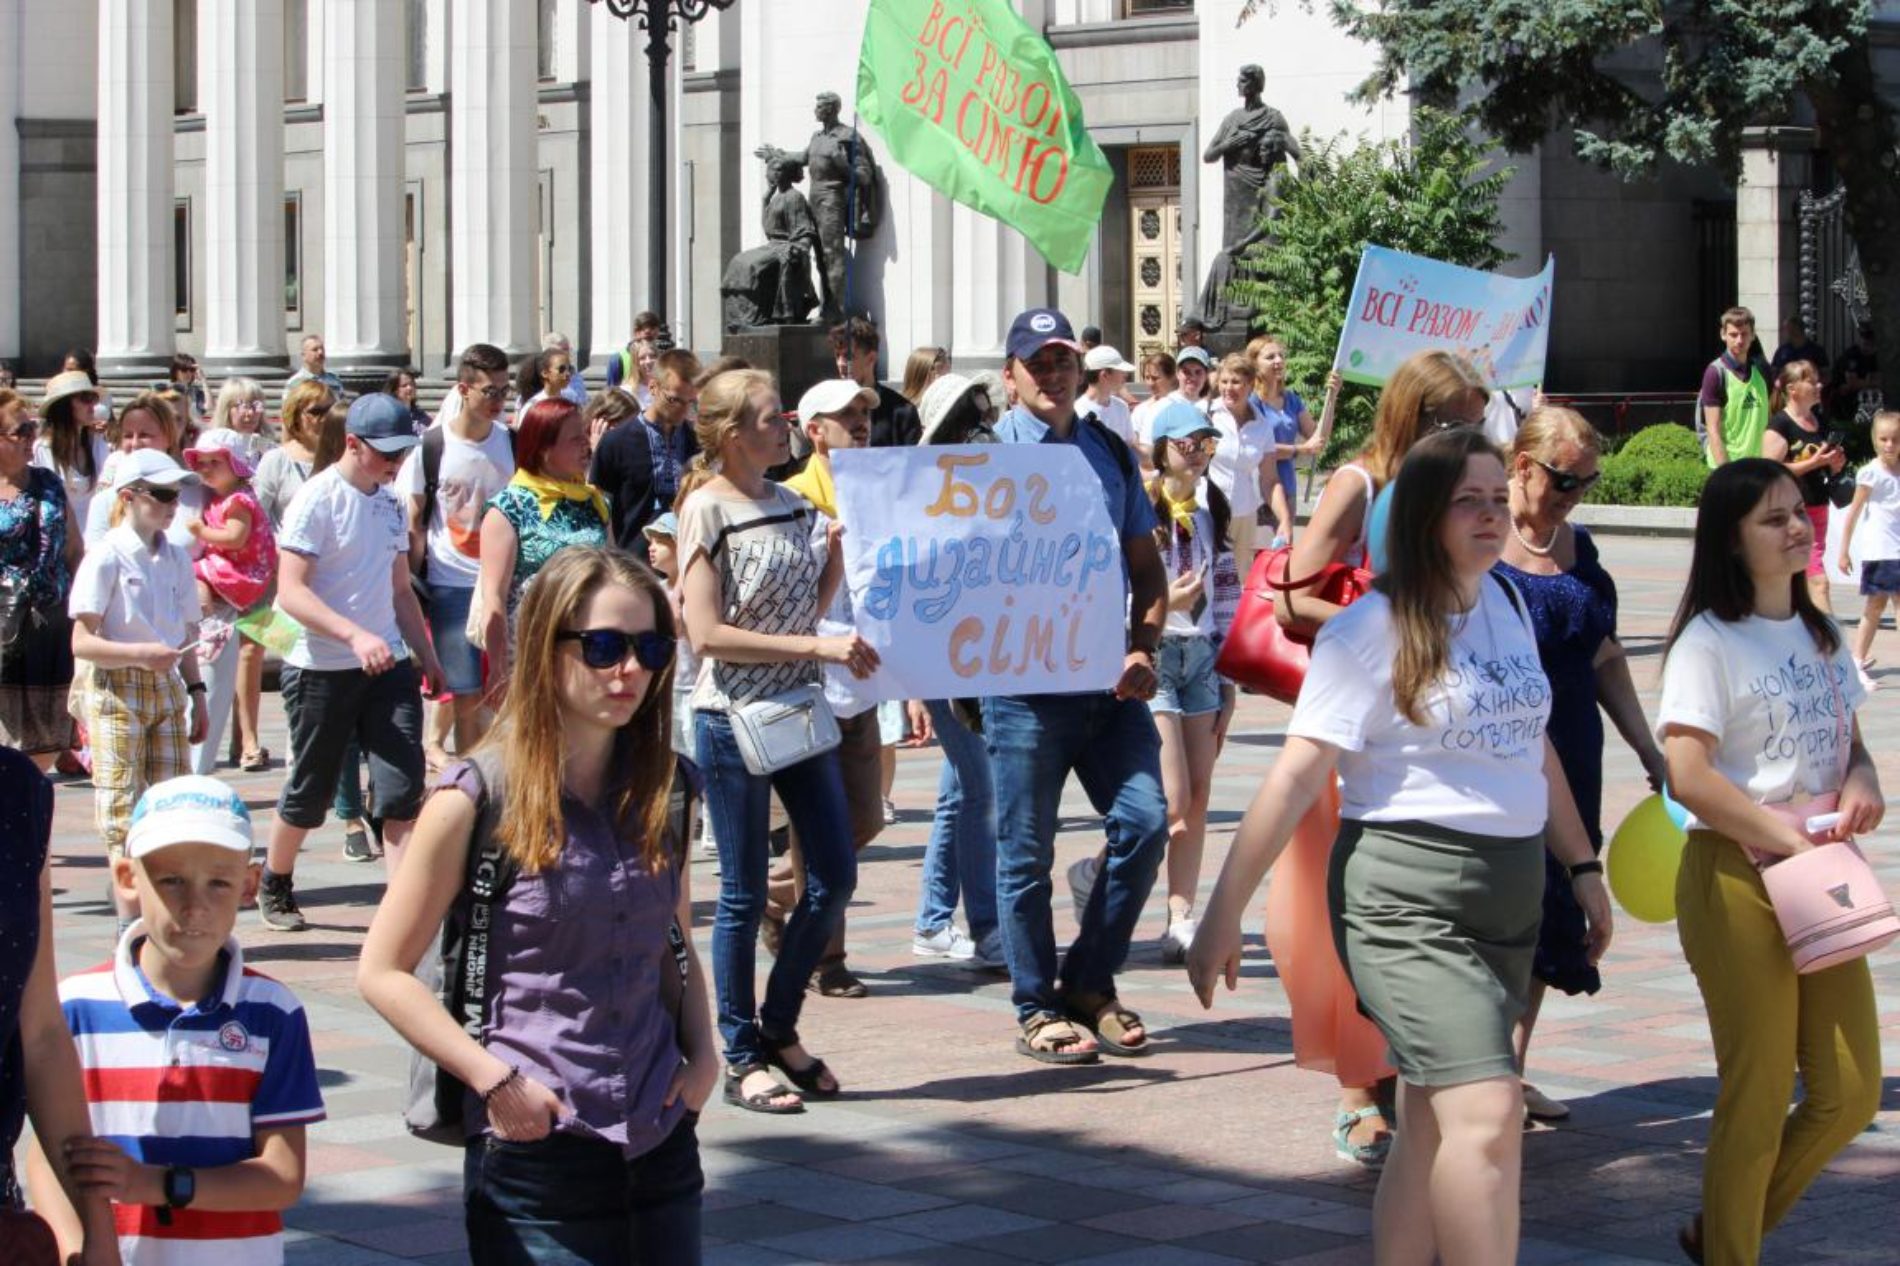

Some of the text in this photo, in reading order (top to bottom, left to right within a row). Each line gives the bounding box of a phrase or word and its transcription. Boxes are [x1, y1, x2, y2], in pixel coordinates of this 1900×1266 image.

[902, 48, 949, 125] ЗА
[1361, 286, 1406, 328] ВСІ
[1408, 298, 1484, 341] РАЗОМ
[925, 452, 1056, 525] Бог
[864, 509, 1113, 624] дизайнер
